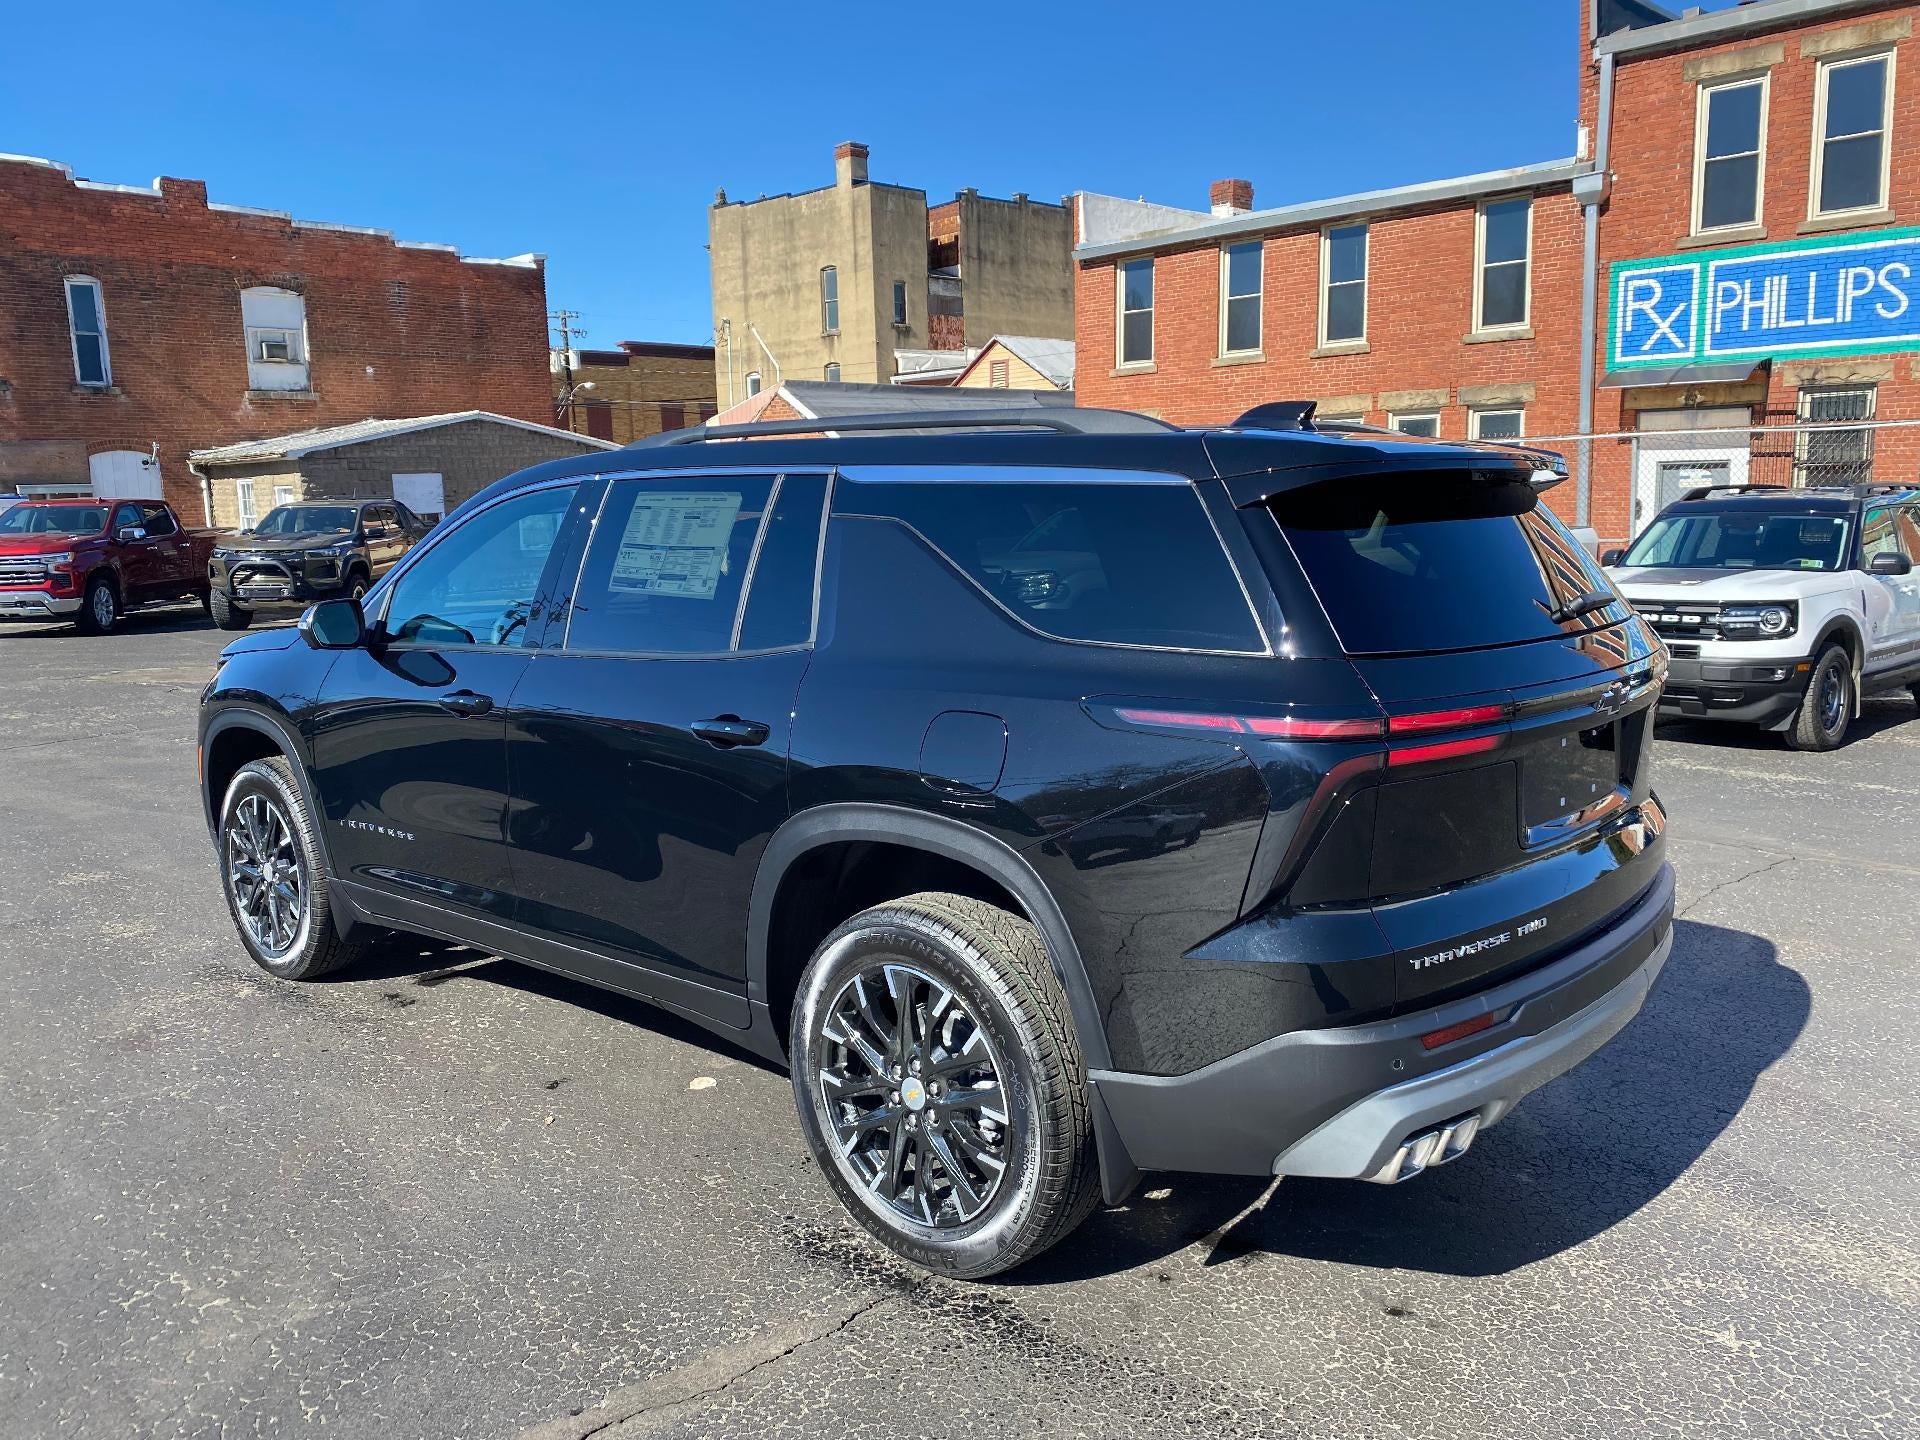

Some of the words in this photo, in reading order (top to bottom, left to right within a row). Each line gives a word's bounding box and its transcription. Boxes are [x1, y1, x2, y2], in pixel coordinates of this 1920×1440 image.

[1714, 262, 1911, 333] PHILLIPS
[338, 819, 416, 841] TRAVERSE
[1409, 931, 1511, 970] TRAVERSE
[1517, 916, 1548, 937] AWD
